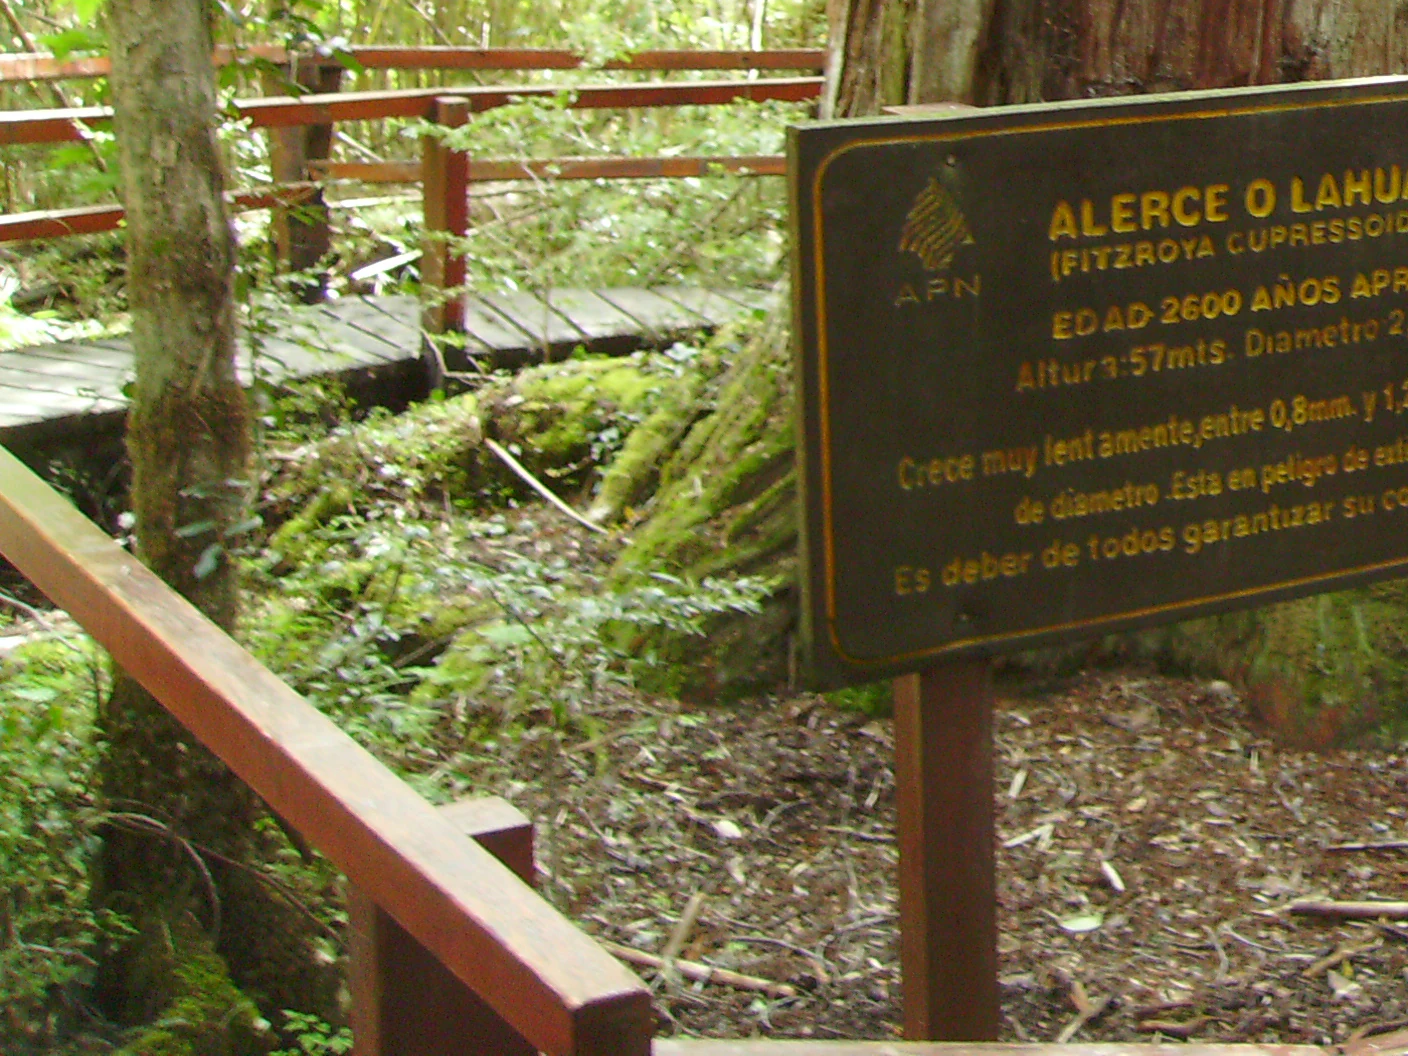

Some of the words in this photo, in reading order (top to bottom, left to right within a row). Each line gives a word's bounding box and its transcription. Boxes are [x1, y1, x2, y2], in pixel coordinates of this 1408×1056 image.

[1048, 183, 1230, 241] ALERCE
[1244, 177, 1277, 219] O
[894, 273, 982, 307] APN
[1050, 235, 1216, 282] (FITZROYA
[1160, 288, 1243, 324] 2600
[1250, 273, 1342, 312] AÑOS
[899, 454, 976, 491] Crece
[982, 445, 1039, 479] muy
[1362, 391, 1378, 423] y
[1015, 496, 1045, 525] de
[1051, 480, 1160, 520] diametro
[1228, 467, 1258, 491] en
[1261, 451, 1338, 494] peligro
[1343, 444, 1370, 473] de
[896, 564, 931, 595] Es
[942, 550, 1033, 587] deber
[1042, 538, 1081, 569] de
[1087, 524, 1177, 561] todos
[1183, 501, 1336, 555] garantizar
[1343, 495, 1376, 519] su
